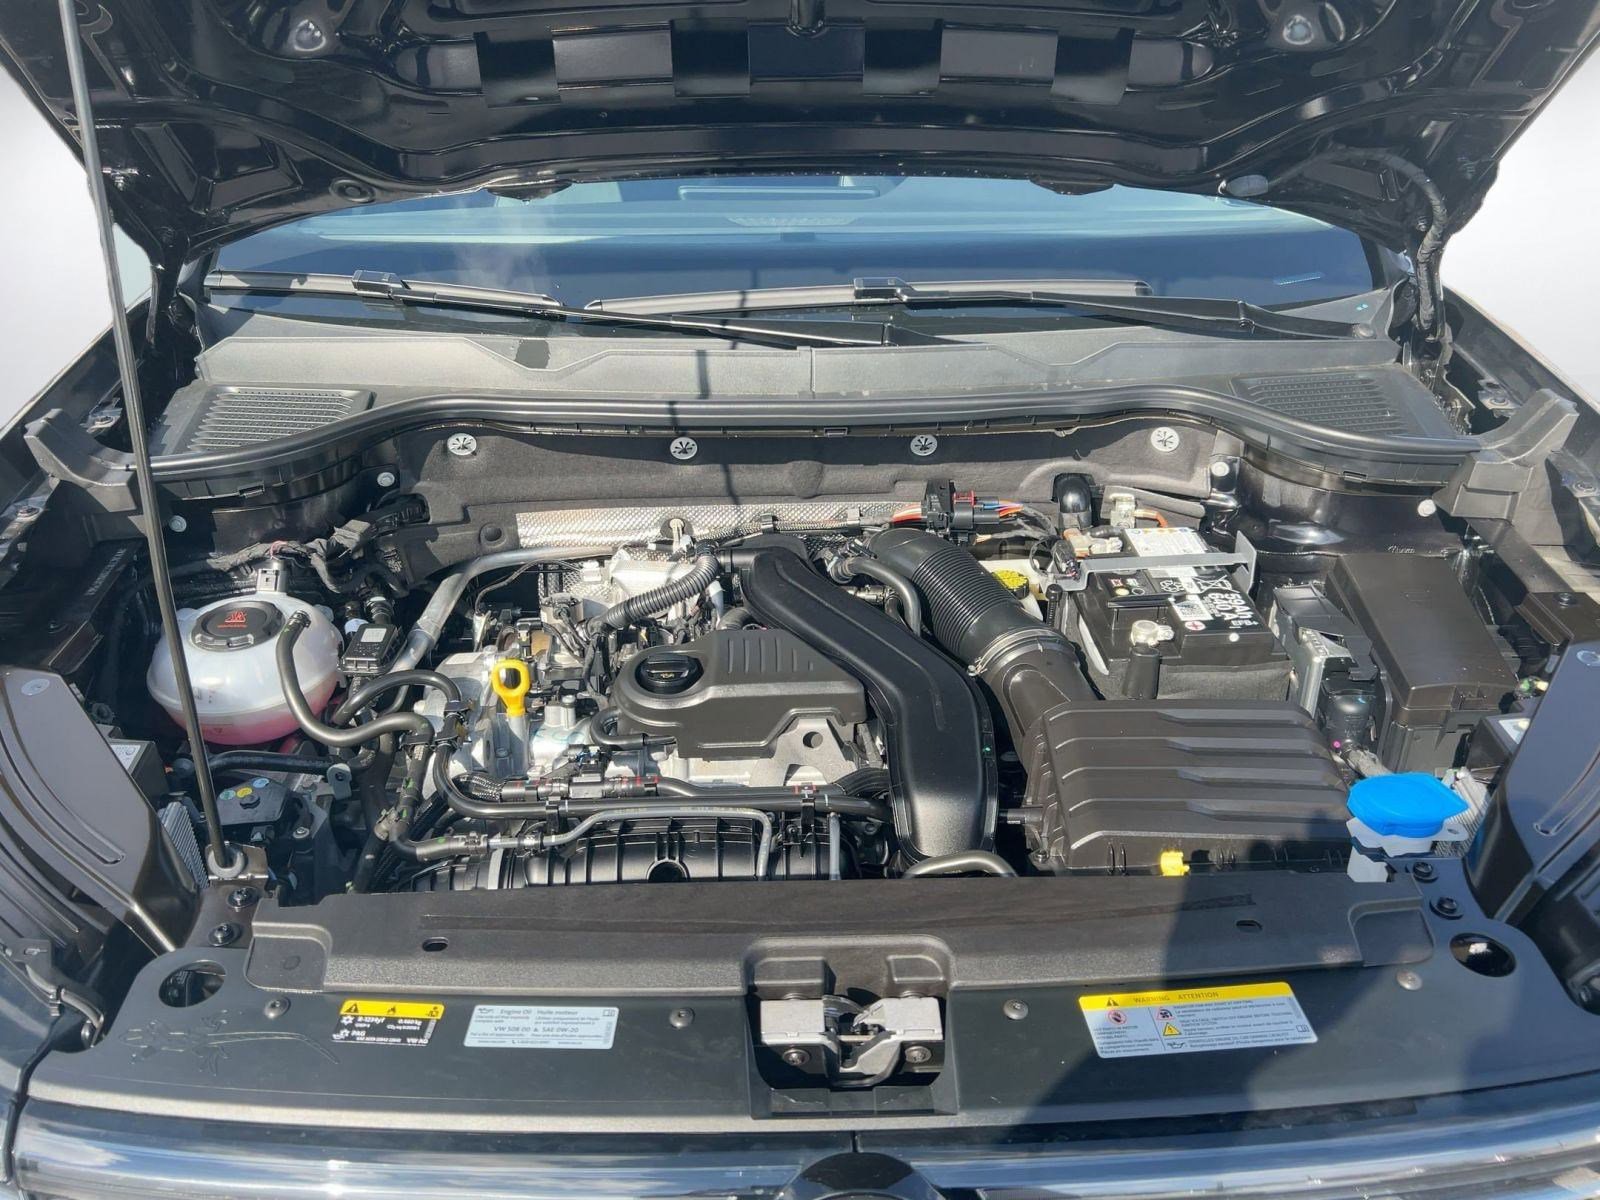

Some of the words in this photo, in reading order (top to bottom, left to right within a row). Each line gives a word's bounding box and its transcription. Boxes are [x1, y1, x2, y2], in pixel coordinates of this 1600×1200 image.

[1208, 593, 1232, 610] 640
[1224, 593, 1254, 618] 59Ah
[1132, 995, 1170, 1004] WARNING
[1178, 991, 1219, 1000] ATTENTION
